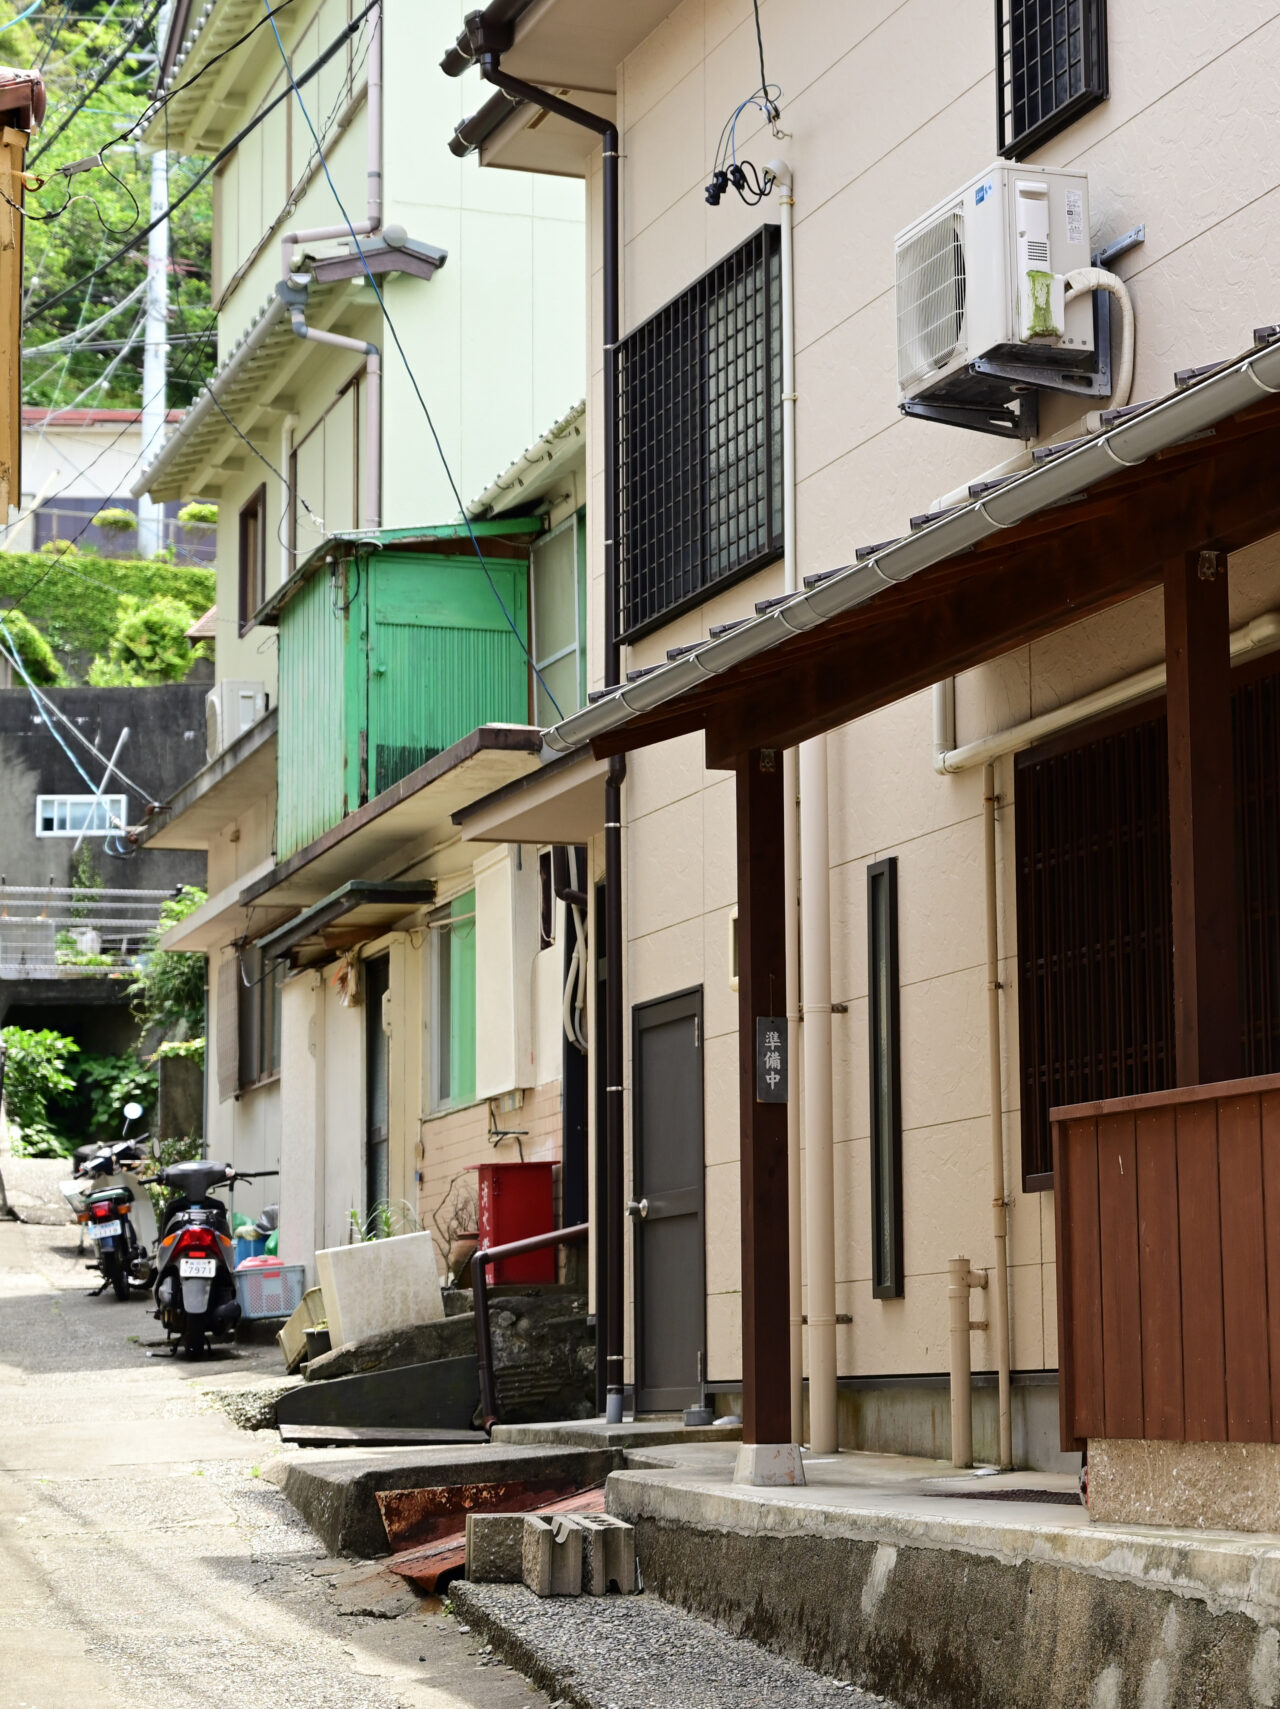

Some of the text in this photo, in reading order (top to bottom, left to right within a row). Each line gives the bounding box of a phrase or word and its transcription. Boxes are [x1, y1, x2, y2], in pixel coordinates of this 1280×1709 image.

[764, 1031, 782, 1091] 準備中
[189, 1265, 212, 1275] 7971
